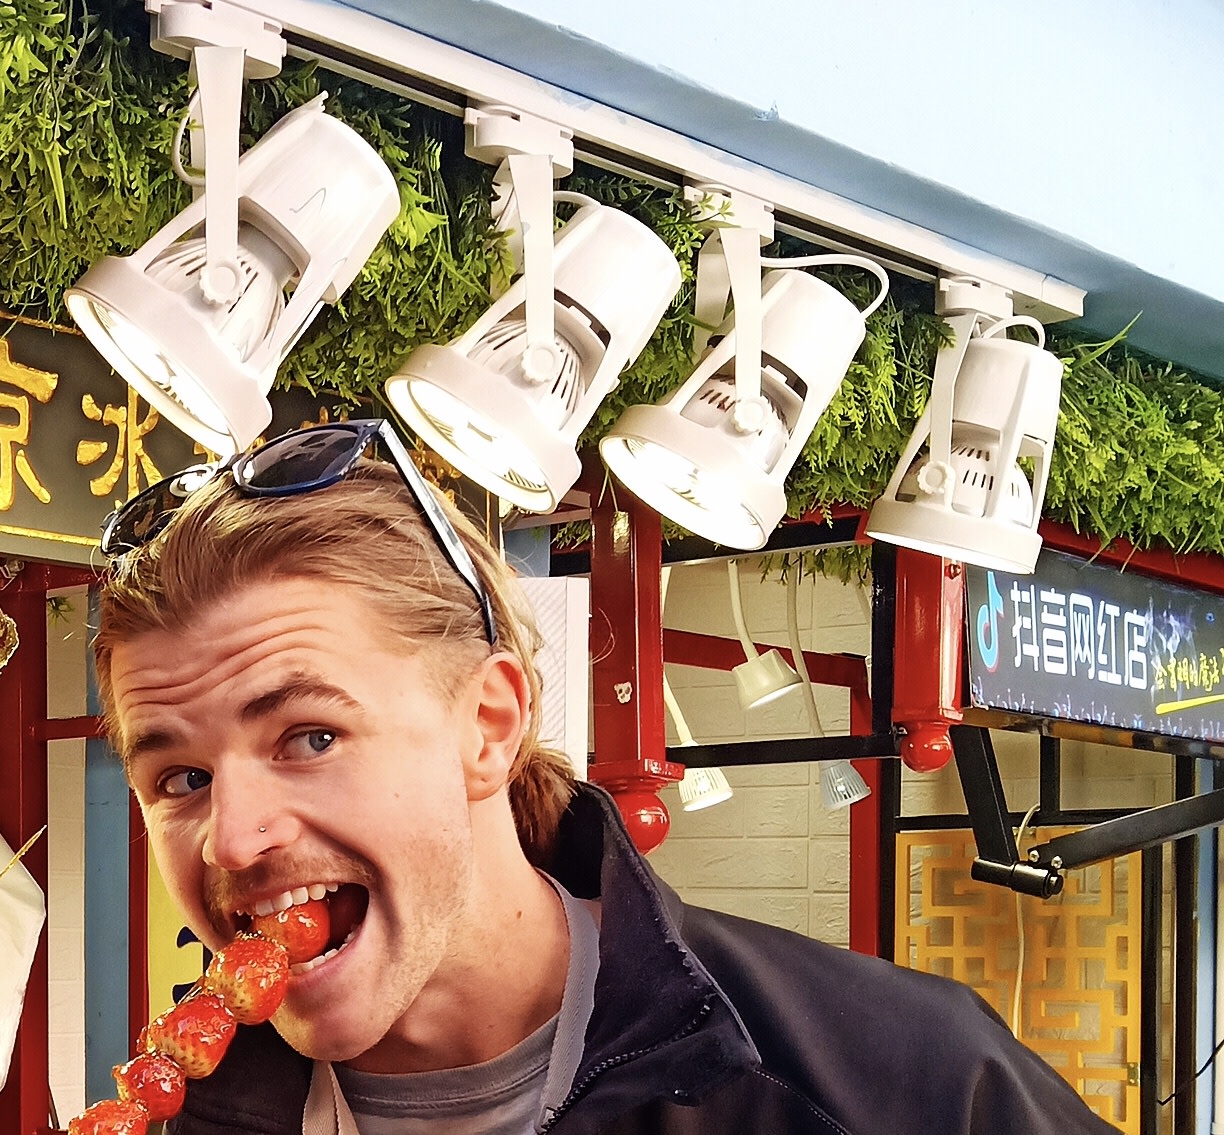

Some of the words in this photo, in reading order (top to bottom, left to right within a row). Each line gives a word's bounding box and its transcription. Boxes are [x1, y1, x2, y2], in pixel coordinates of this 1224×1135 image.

[1010, 581, 1148, 690] 抖音网红店
